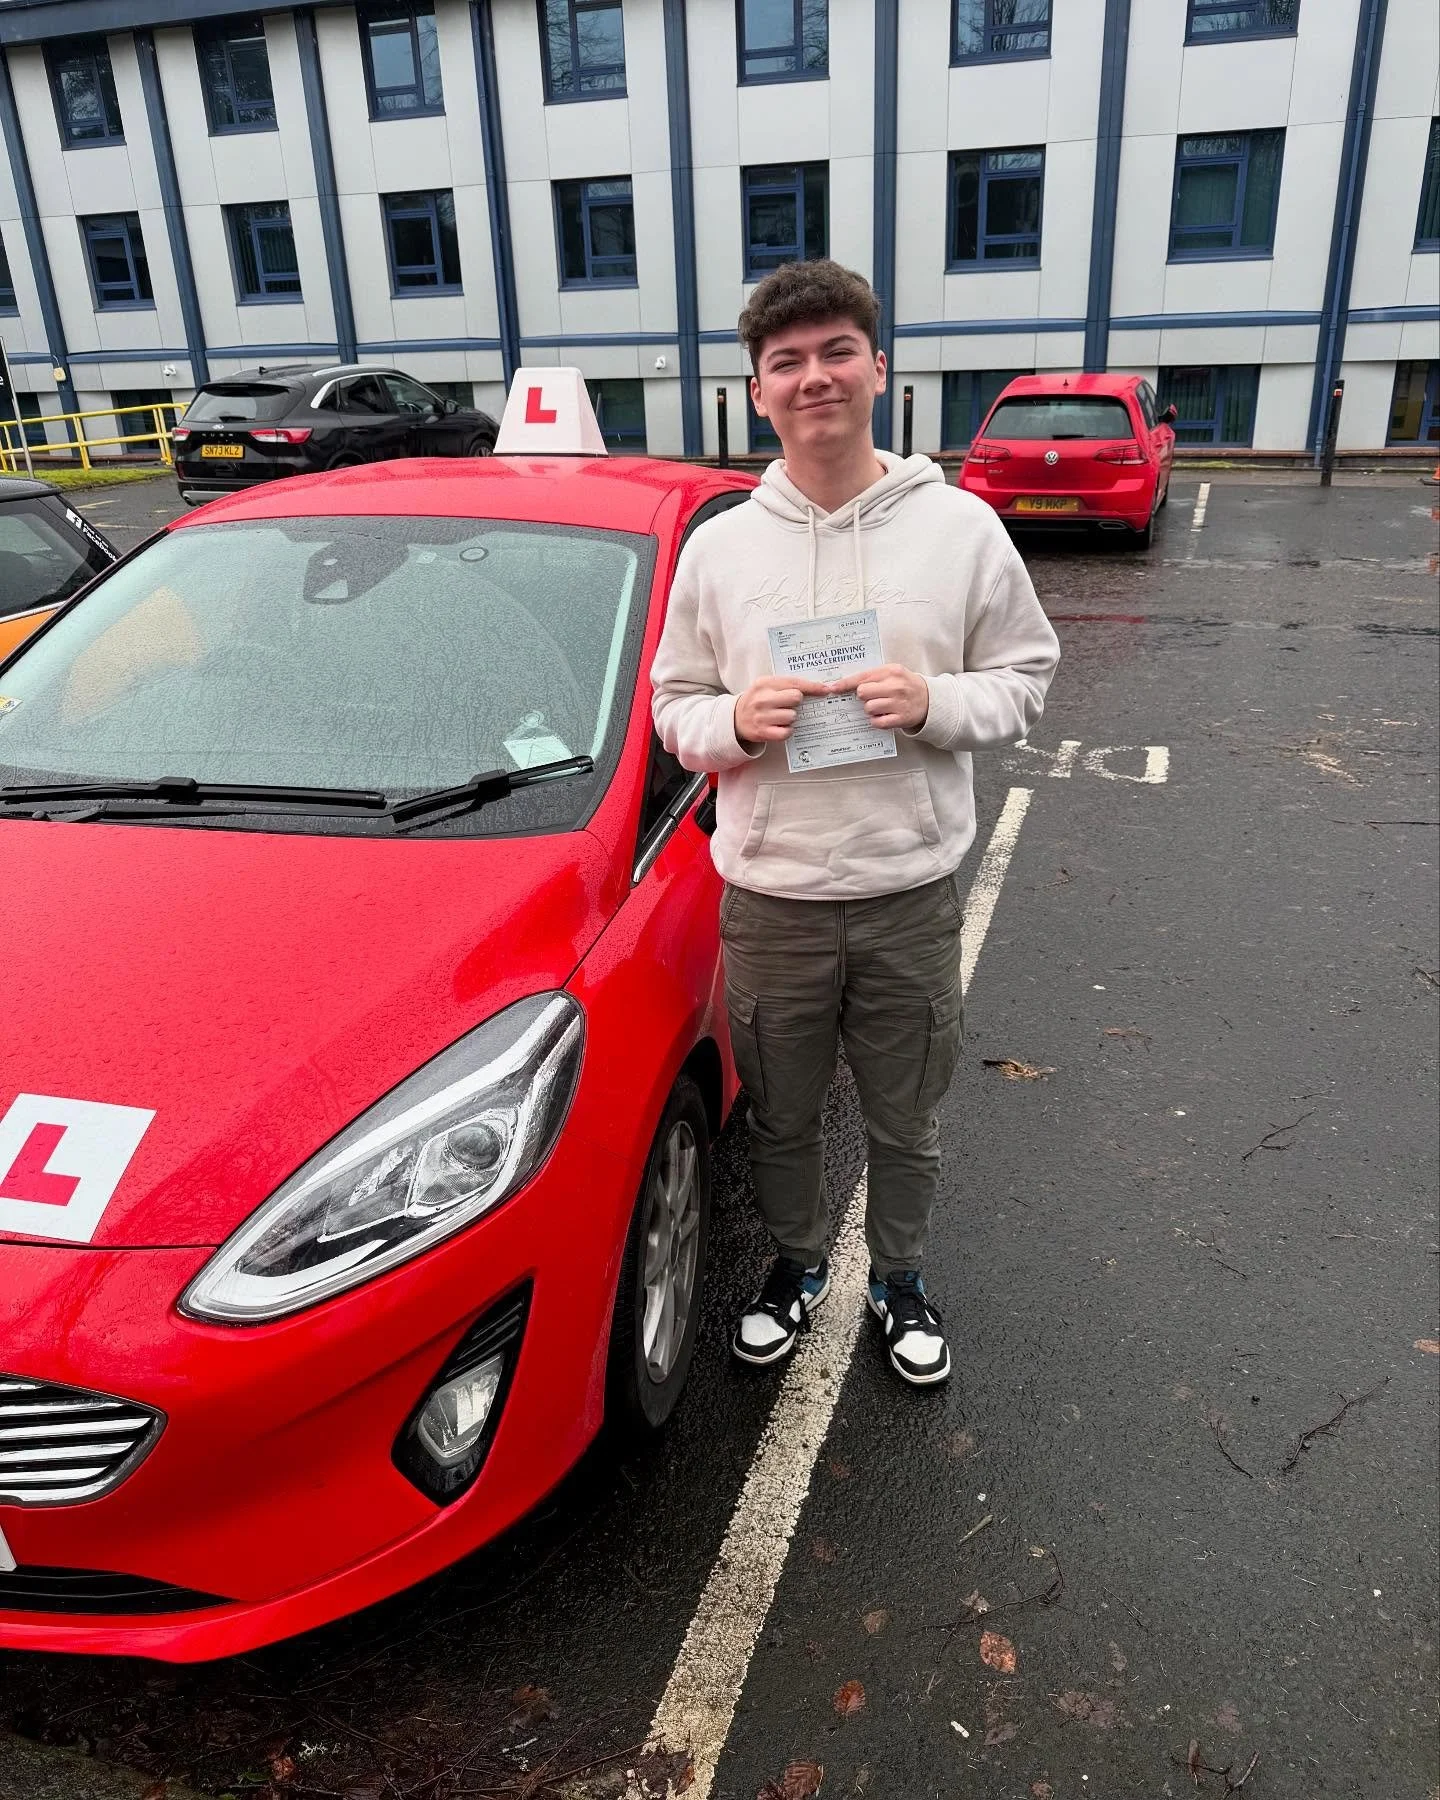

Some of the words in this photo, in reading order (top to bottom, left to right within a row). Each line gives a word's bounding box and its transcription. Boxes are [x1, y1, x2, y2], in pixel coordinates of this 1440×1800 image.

[525, 387, 557, 423] L
[205, 446, 223, 456] SN73
[224, 446, 239, 456] KLZ
[787, 651, 830, 664] PRACTICAL
[830, 644, 866, 656] DRIVING
[789, 662, 807, 671] TEST
[806, 660, 823, 668] PASS
[823, 652, 866, 665] CERTIFICATE
[0, 1122, 81, 1207] L
